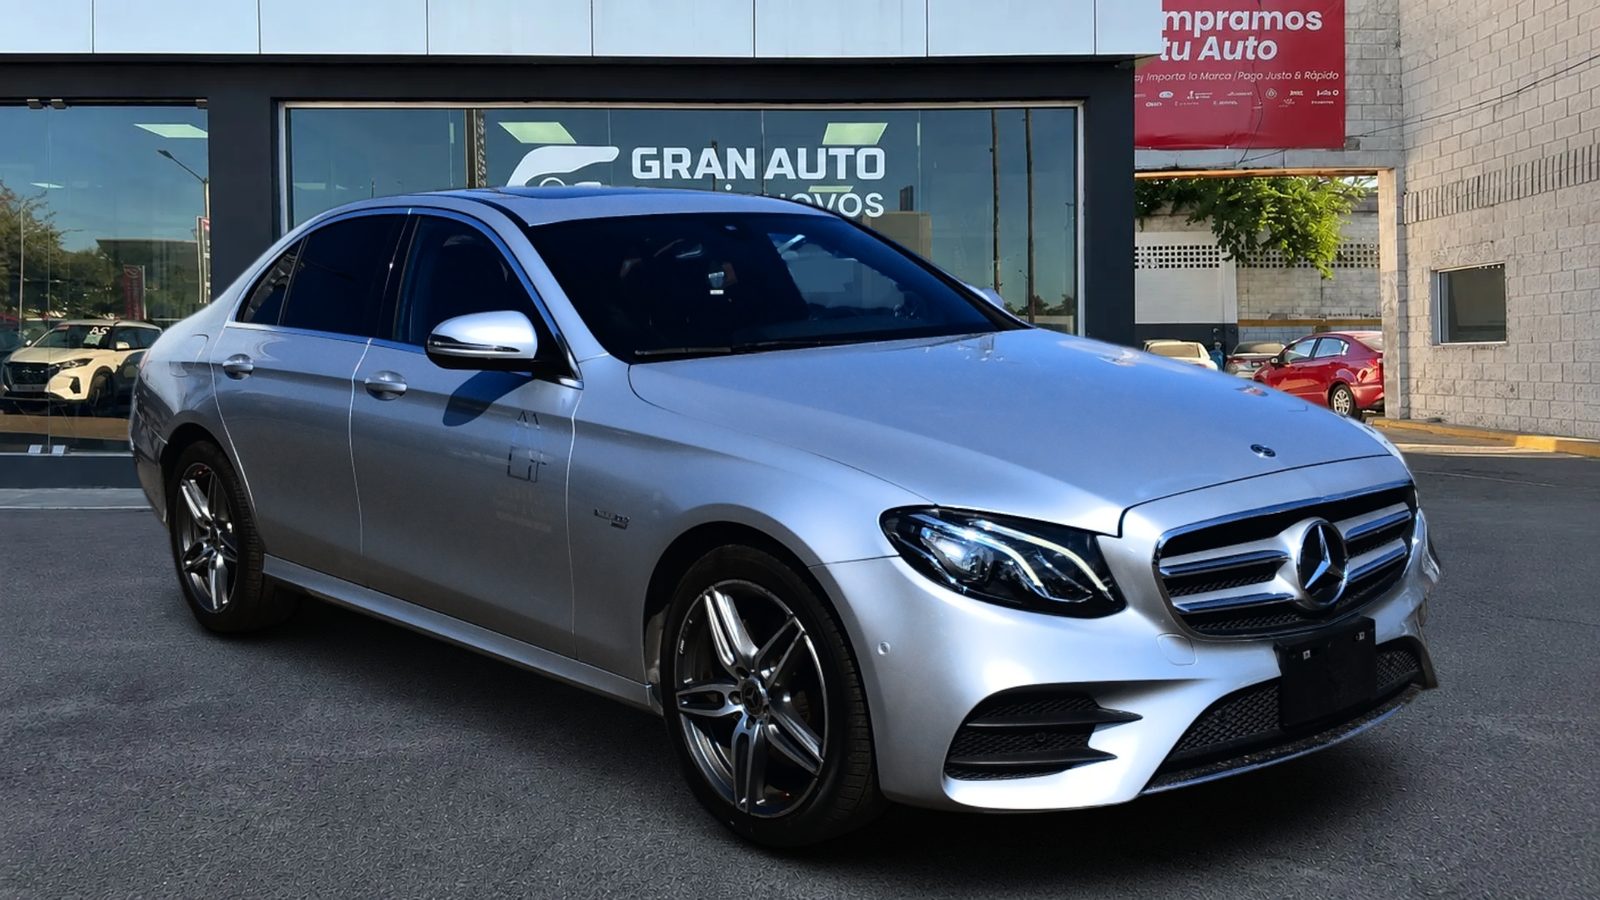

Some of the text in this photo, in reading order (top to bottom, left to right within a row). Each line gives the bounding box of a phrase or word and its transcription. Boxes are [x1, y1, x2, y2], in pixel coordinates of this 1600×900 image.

[1160, 36, 1278, 62] tu Auto
[1146, 72, 1186, 83] Importa
[1188, 72, 1198, 80] la
[1199, 71, 1232, 81] Marca
[1265, 71, 1293, 80] Justo
[1294, 71, 1301, 80] &
[631, 146, 886, 180] GRAN AUTO
